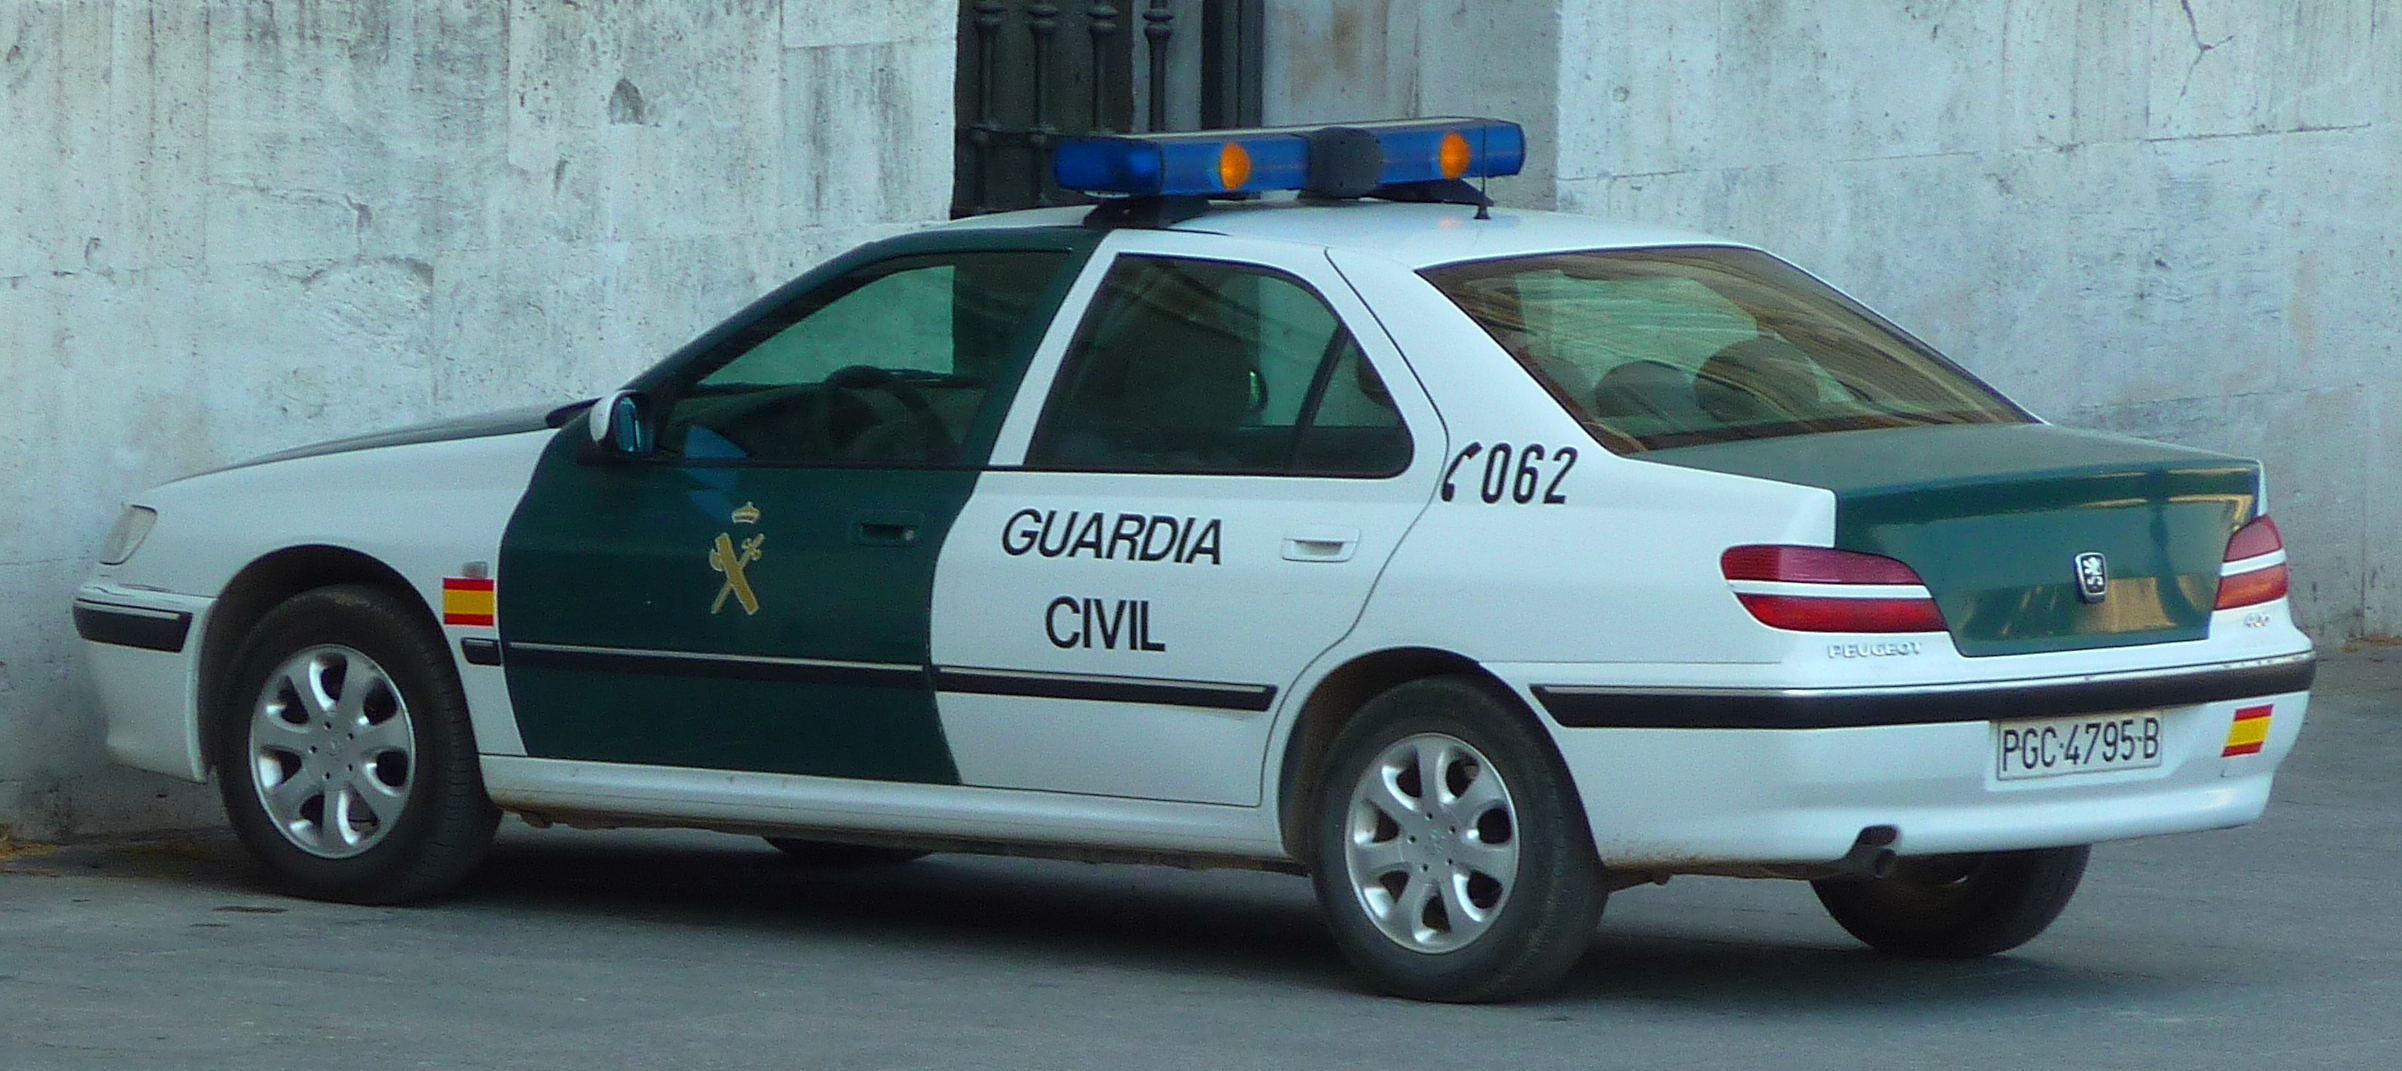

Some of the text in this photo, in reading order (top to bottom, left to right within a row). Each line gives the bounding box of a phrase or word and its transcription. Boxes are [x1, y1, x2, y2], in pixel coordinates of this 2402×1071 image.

[1479, 442, 1578, 505] 062
[1001, 508, 1222, 565] GUARDIA
[1045, 595, 1166, 652] CIVIL
[1827, 641, 1922, 659] PEUGEOT
